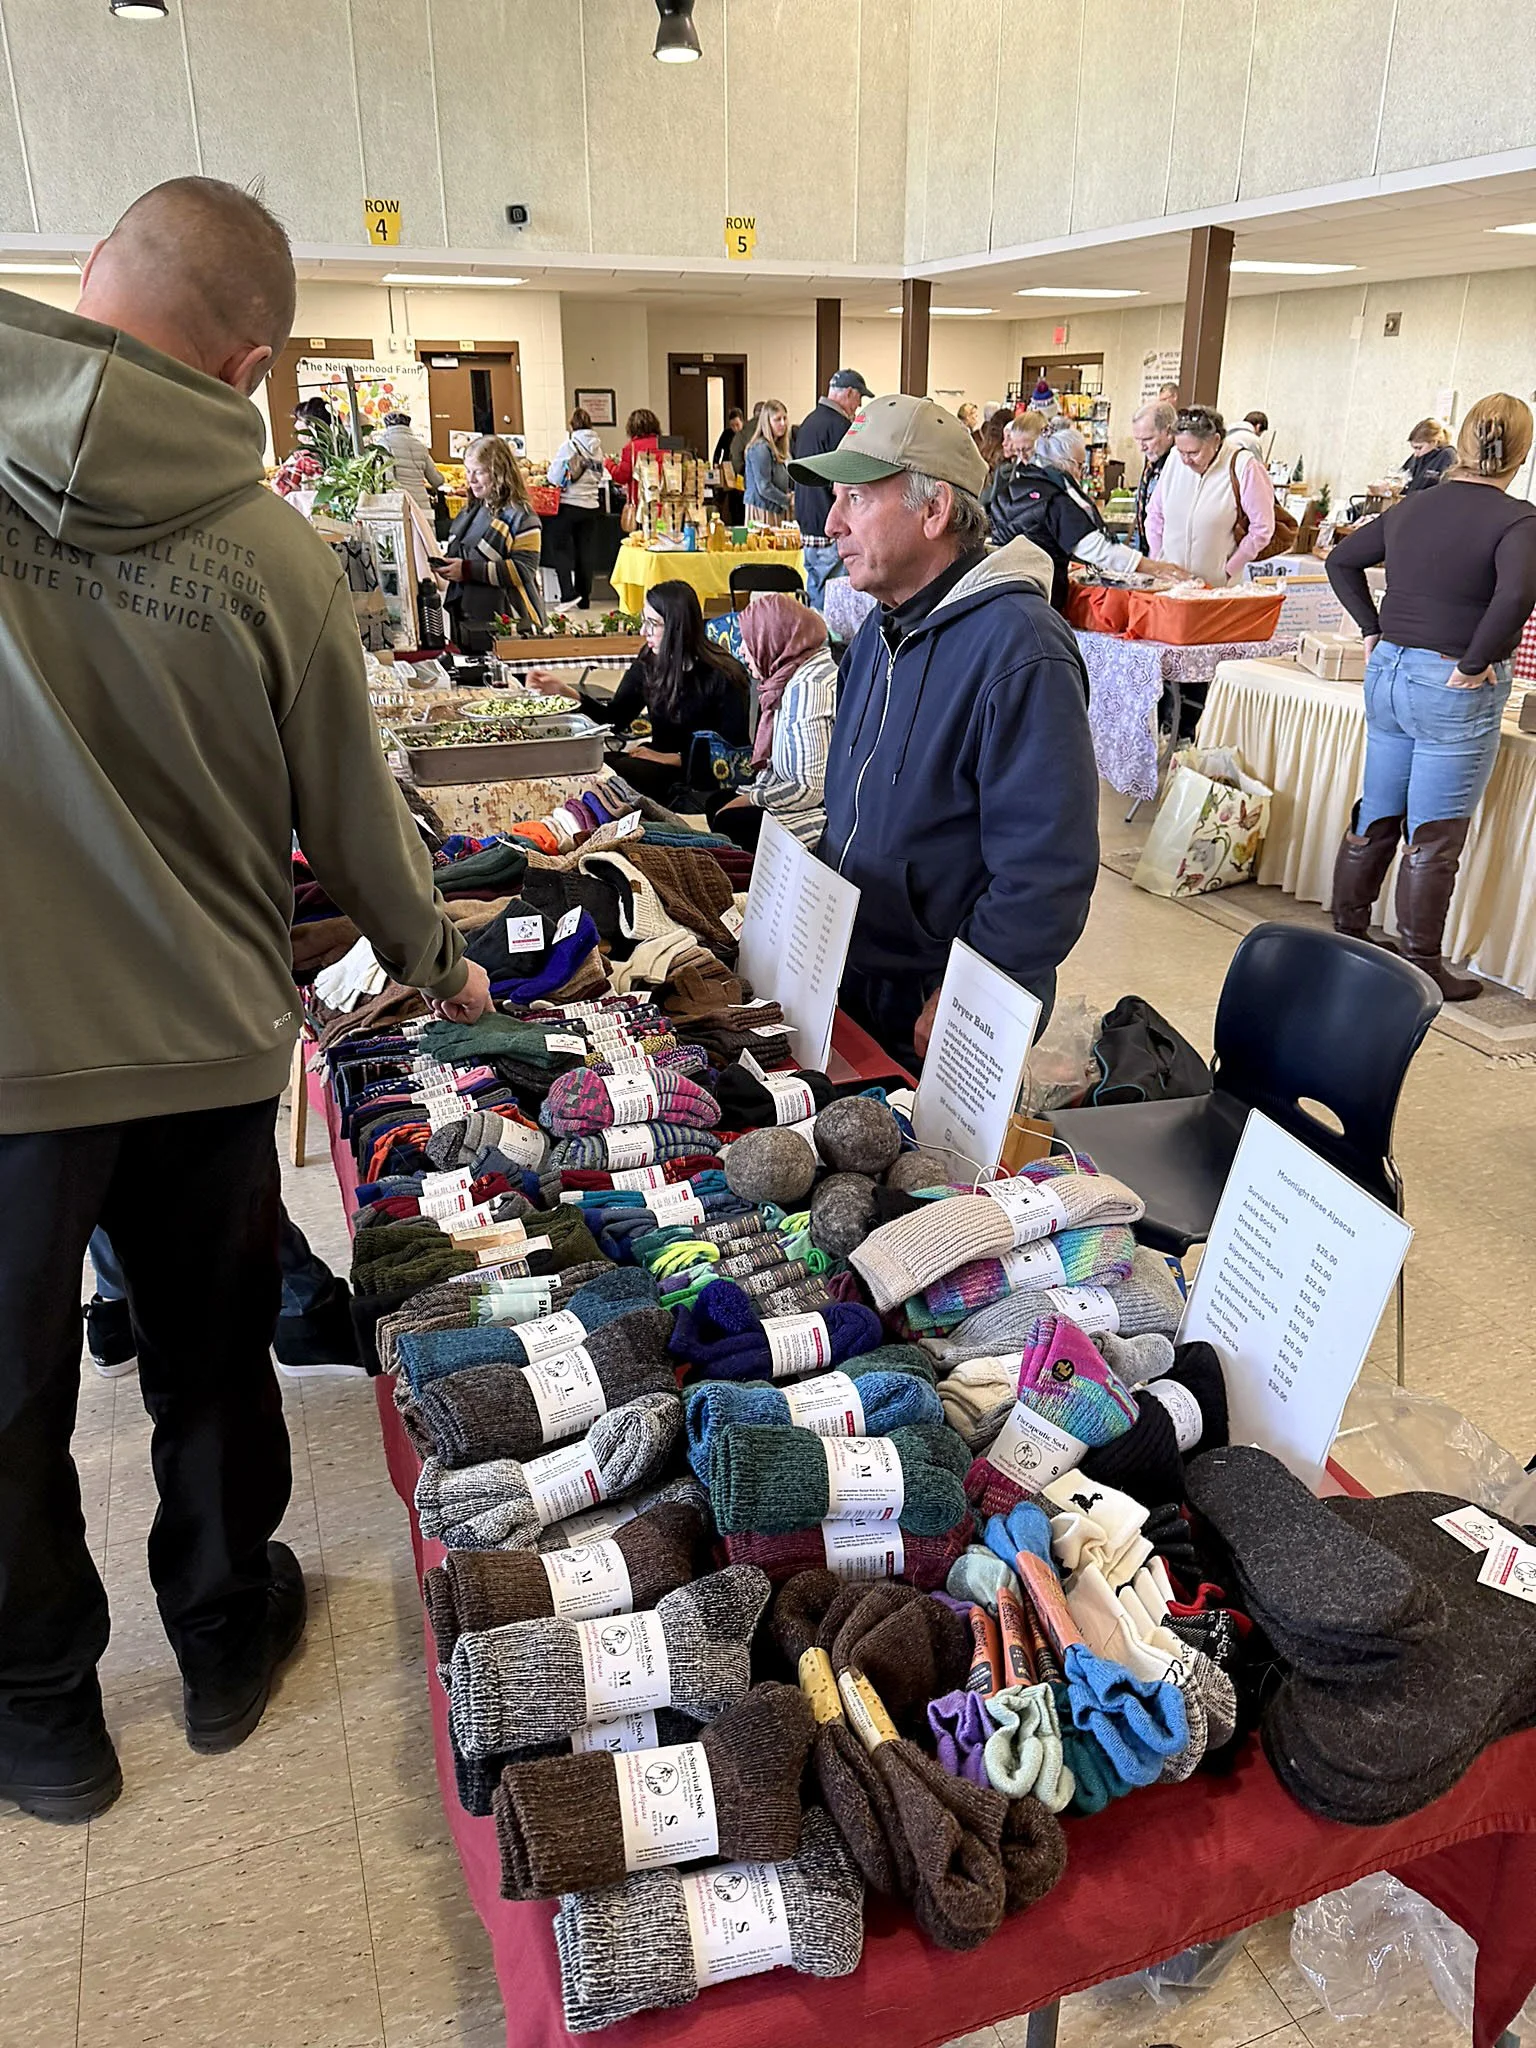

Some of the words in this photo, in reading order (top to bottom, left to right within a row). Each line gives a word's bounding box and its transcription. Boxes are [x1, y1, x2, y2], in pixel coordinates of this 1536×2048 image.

[365, 199, 399, 213] ROW
[726, 217, 755, 229] ROW
[376, 218, 388, 241] 4
[737, 235, 747, 253] 5
[305, 362, 322, 372] The
[325, 362, 393, 374] Neigborhood
[34, 535, 98, 569] EAST
[189, 552, 267, 603] LEAGUE
[76, 575, 104, 600] TO
[118, 590, 214, 633] SERVICE
[170, 575, 213, 603] EST
[219, 592, 266, 628] 1960
[952, 996, 974, 1022] Dryer
[975, 1015, 995, 1039] Balls
[1276, 1168, 1310, 1201] Moonlight
[1309, 1194, 1327, 1214] Rose
[1326, 1209, 1356, 1240] Alpacas
[1242, 1198, 1259, 1218] Ankle
[1258, 1212, 1277, 1234] Socks
[1310, 1258, 1332, 1282] $22.00
[1247, 1184, 1271, 1208] Survival
[1270, 1203, 1289, 1224] Socks
[1315, 1242, 1338, 1266] $25.00
[1232, 1227, 1266, 1264] Therapeutic
[1265, 1257, 1284, 1279] Socks
[1298, 1288, 1320, 1313] $25.00
[1237, 1213, 1254, 1233] Dress
[1253, 1228, 1272, 1249] Socks
[1304, 1273, 1326, 1298] $22.00
[1223, 1256, 1260, 1297] Outdoorsman
[1260, 1292, 1278, 1314] Socks
[1287, 1319, 1309, 1344] $30.00
[1227, 1242, 1248, 1266] Slipper
[1247, 1260, 1265, 1282] Socks
[1293, 1303, 1314, 1328] $25.00
[1209, 1298, 1222, 1315] Boot
[1221, 1311, 1239, 1333] Liners
[1213, 1284, 1224, 1300] Leg
[1224, 1295, 1248, 1324] Warmers
[1205, 1312, 1222, 1335] Sports
[1221, 1329, 1239, 1353] Socks
[1247, 1298, 1265, 1322] Socks
[1282, 1333, 1303, 1359] $20.00
[1015, 1414, 1053, 1442] Therapeutic
[1050, 1437, 1070, 1452] Socks
[859, 1465, 871, 1477] M
[1048, 1465, 1061, 1475] S
[579, 1569, 593, 1583] M
[639, 1620, 652, 1653] Survival
[617, 1669, 631, 1687] M
[644, 1653, 655, 1676] Sock
[634, 1720, 645, 1743] Sock
[688, 1756, 702, 1792] Survival
[664, 1813, 678, 1826] S
[694, 1793, 706, 1819] Sock
[757, 1863, 772, 1896] Survival
[765, 1897, 778, 1924] Sock
[734, 1920, 750, 1934] S
